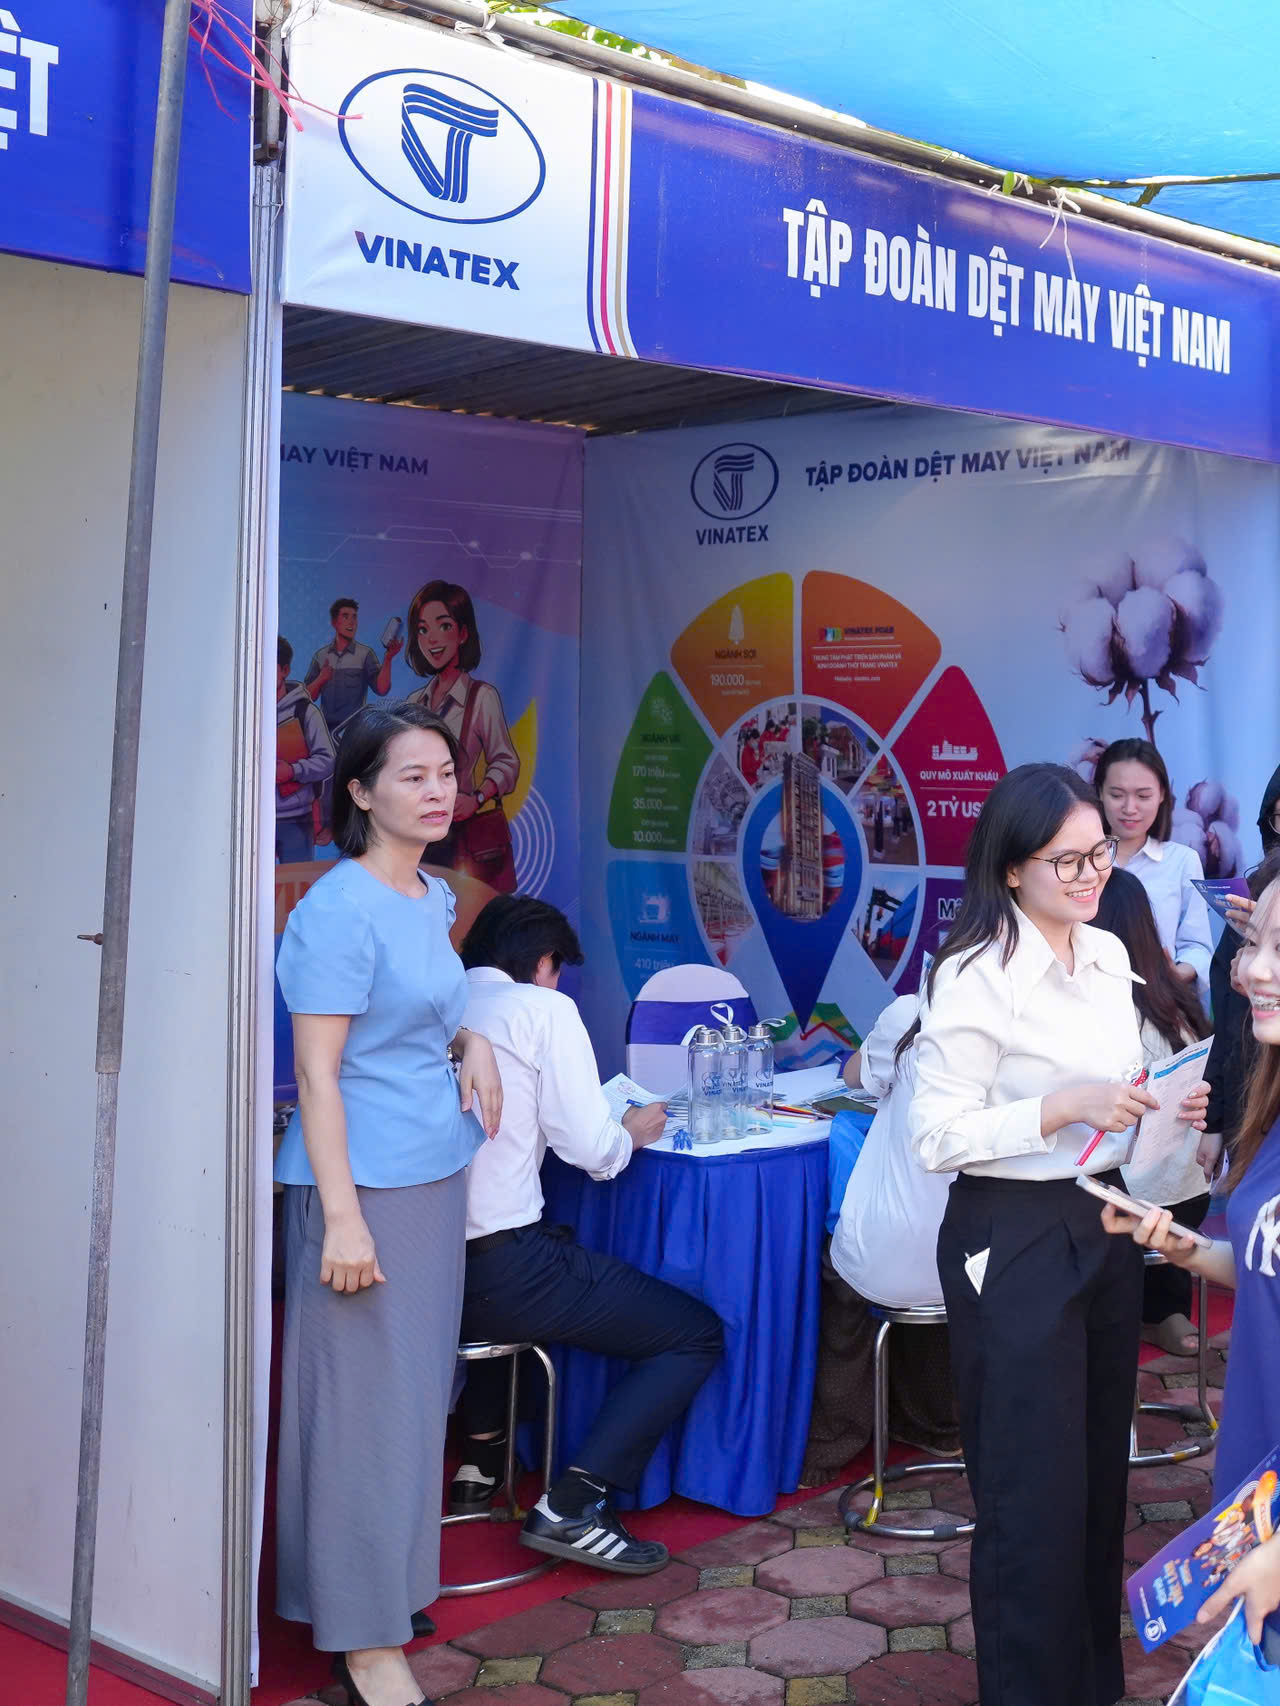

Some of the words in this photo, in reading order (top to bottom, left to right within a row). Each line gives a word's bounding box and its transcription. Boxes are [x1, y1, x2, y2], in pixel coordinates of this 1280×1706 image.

[354, 230, 519, 291] VINATEX
[782, 197, 853, 298] TẬP
[863, 223, 957, 313] ĐOÀN
[967, 244, 1025, 337] DỆT
[1033, 271, 1102, 344] MAY
[1108, 283, 1165, 369] VIỆT
[1172, 305, 1232, 375] NAM
[323, 446, 373, 473] VIỆT
[379, 454, 429, 475] NAM
[805, 460, 843, 491] TẬP
[848, 453, 908, 483] ĐOÀN
[914, 450, 955, 483] DỆT
[961, 450, 1010, 474] MAY
[1017, 446, 1066, 474] VIỆT
[1074, 440, 1131, 464] NAM
[696, 525, 769, 546] VINATEX
[710, 674, 744, 686] 190.000
[920, 770, 937, 780] QUY
[938, 769, 952, 780] MÔ
[952, 769, 974, 781] XUẤT
[927, 800, 937, 817] 2
[938, 795, 959, 817] TỶ
[961, 801, 985, 818] US
[632, 831, 663, 843] 10.000
